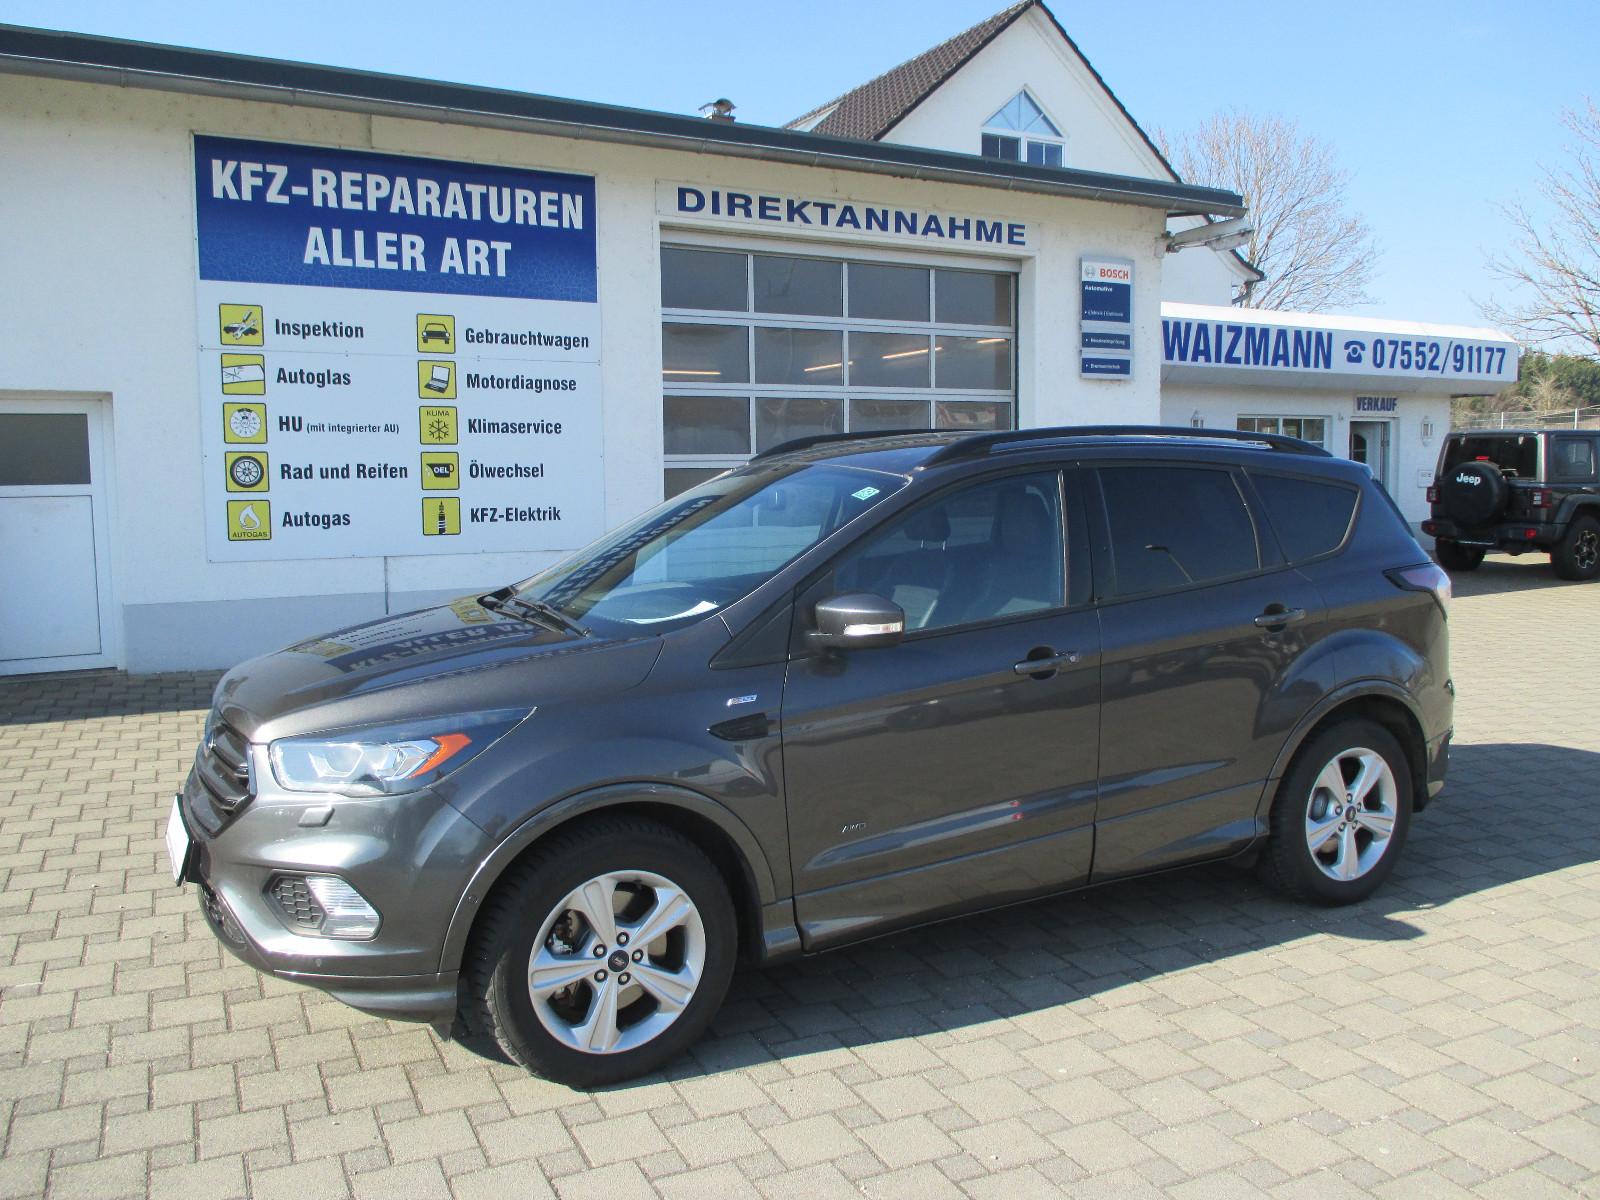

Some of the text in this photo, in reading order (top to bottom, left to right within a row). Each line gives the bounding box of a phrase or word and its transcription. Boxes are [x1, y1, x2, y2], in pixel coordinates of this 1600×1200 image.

[211, 159, 584, 230] KFZ-REPARATUREN
[677, 186, 1026, 246] DIREKTANNAHME
[303, 226, 512, 277] ALLER ART
[1100, 268, 1129, 280] BOSCH
[275, 319, 364, 339] Inspektion
[465, 328, 589, 350] Gebrauchtwagen
[1162, 320, 1506, 375] WAIZMANN 07552/91177
[276, 368, 351, 388] Autoglas
[466, 374, 577, 393] Motordiagnose
[1356, 396, 1398, 412] VERKAUF
[278, 416, 400, 434] HU (mit integrierter AU)
[468, 419, 562, 434] Klimaservice
[280, 463, 408, 479] Rad und Reifen
[433, 466, 449, 474] OEL
[469, 459, 544, 479] Ölwechsel
[1456, 472, 1481, 486] Jeep
[282, 511, 351, 529] Autogas
[470, 507, 561, 523] KFZ-Elektrik
[232, 530, 267, 538] AUTOGAS
